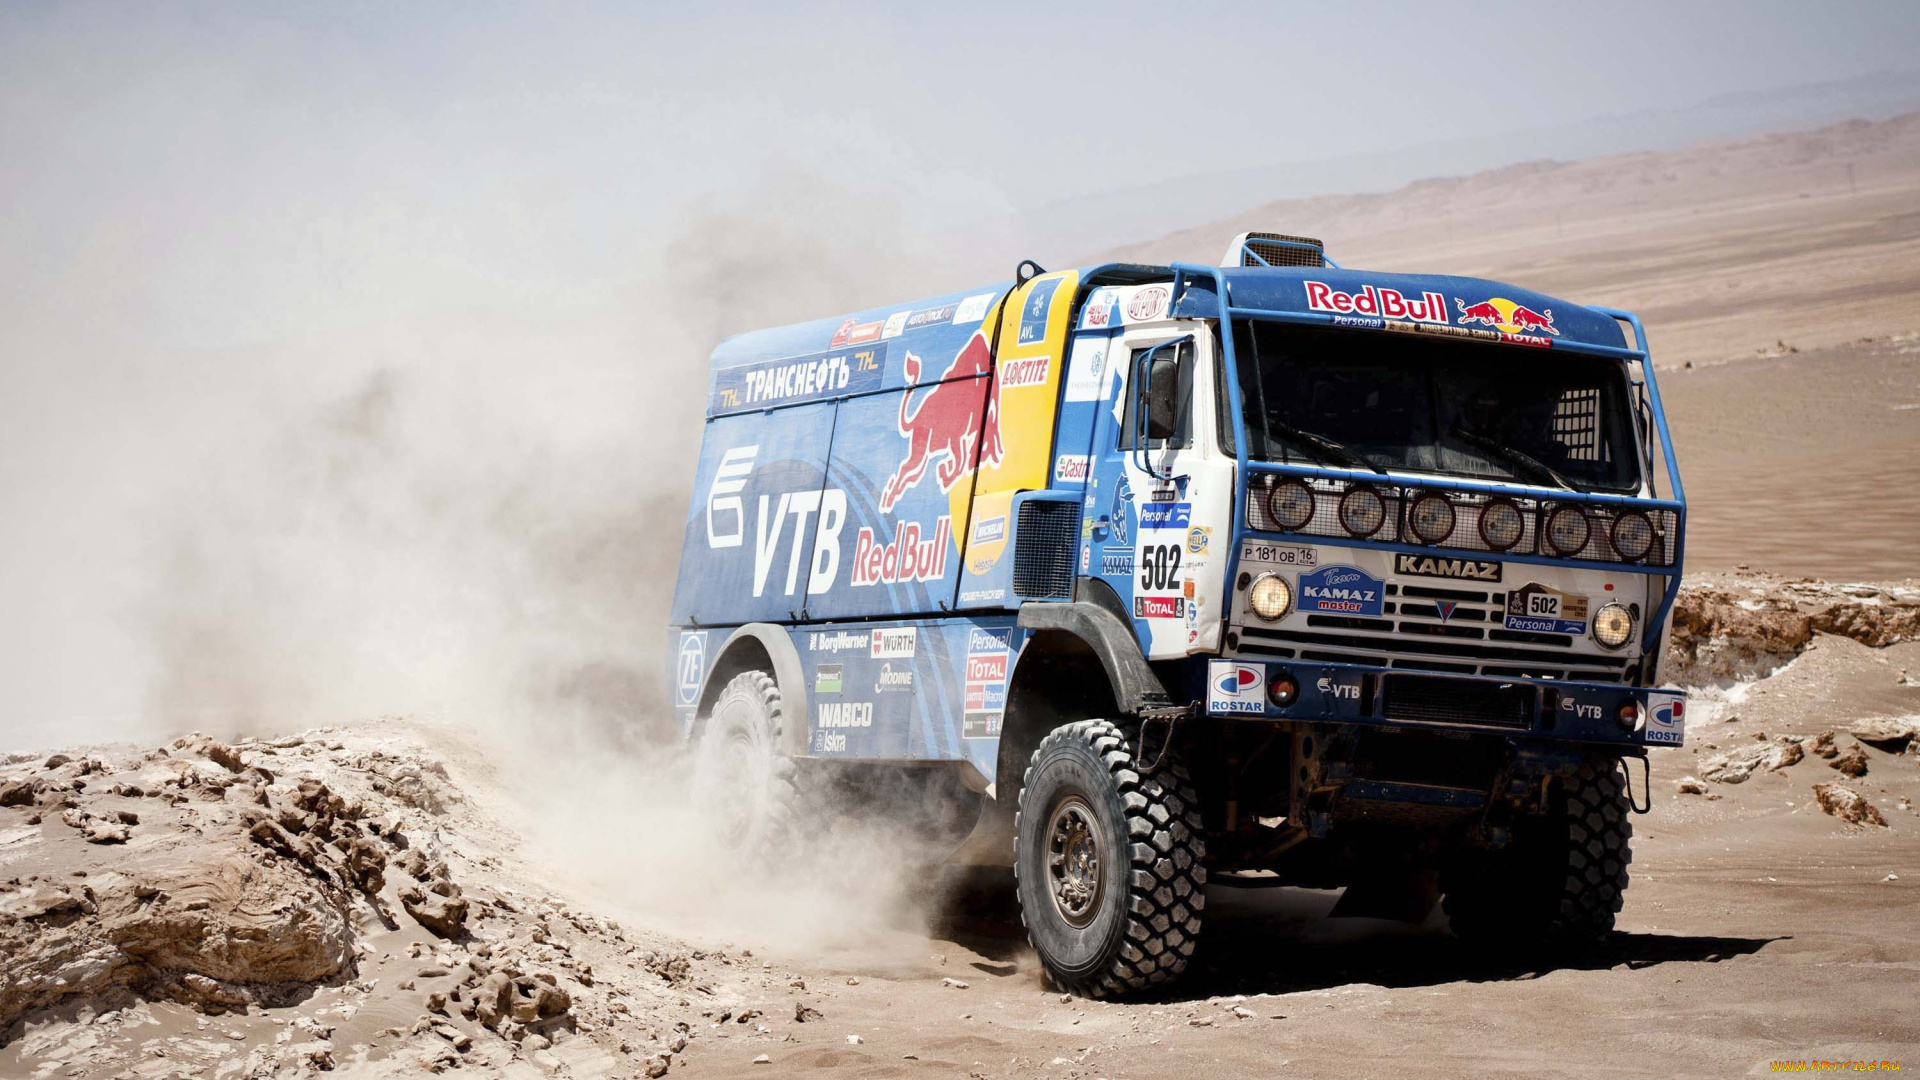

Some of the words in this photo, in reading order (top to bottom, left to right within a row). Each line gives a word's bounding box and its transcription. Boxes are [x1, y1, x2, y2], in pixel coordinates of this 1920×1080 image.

[1304, 281, 1380, 316] Red
[1377, 287, 1449, 325] Bull
[1334, 315, 1381, 328] Personal
[1021, 326, 1034, 339] AVL
[1504, 333, 1550, 345] TOTAL
[745, 356, 849, 403] ТРАНСНЕФТЬ
[1002, 359, 1048, 385] LOCTITE
[1064, 458, 1094, 478] Castrl
[1141, 508, 1172, 522] Personal
[752, 489, 847, 598] VTB
[850, 520, 905, 587] Red
[899, 515, 952, 583] Bull
[1256, 547, 1276, 561] 181
[1300, 549, 1312, 559] 16
[1101, 555, 1133, 575] KAMAZ
[1141, 544, 1182, 590] 502
[1400, 556, 1499, 579] KAMAZ
[1323, 568, 1360, 586] Team
[1304, 586, 1376, 602] KAMAZ
[1144, 600, 1174, 614] TOTAL
[1318, 601, 1363, 613] master
[1531, 597, 1557, 614] 502
[1508, 617, 1556, 631] Personal
[819, 632, 869, 653] BorgWarner
[971, 630, 1010, 650] Personal
[681, 649, 702, 689] ZF
[970, 659, 1004, 678] TOTAL
[880, 672, 912, 685] MODINE
[1333, 684, 1361, 700] VTB
[819, 702, 873, 727] WABCO
[1212, 701, 1262, 712] ROSTAR
[1576, 705, 1602, 719] VTB
[824, 730, 846, 752] Iskra
